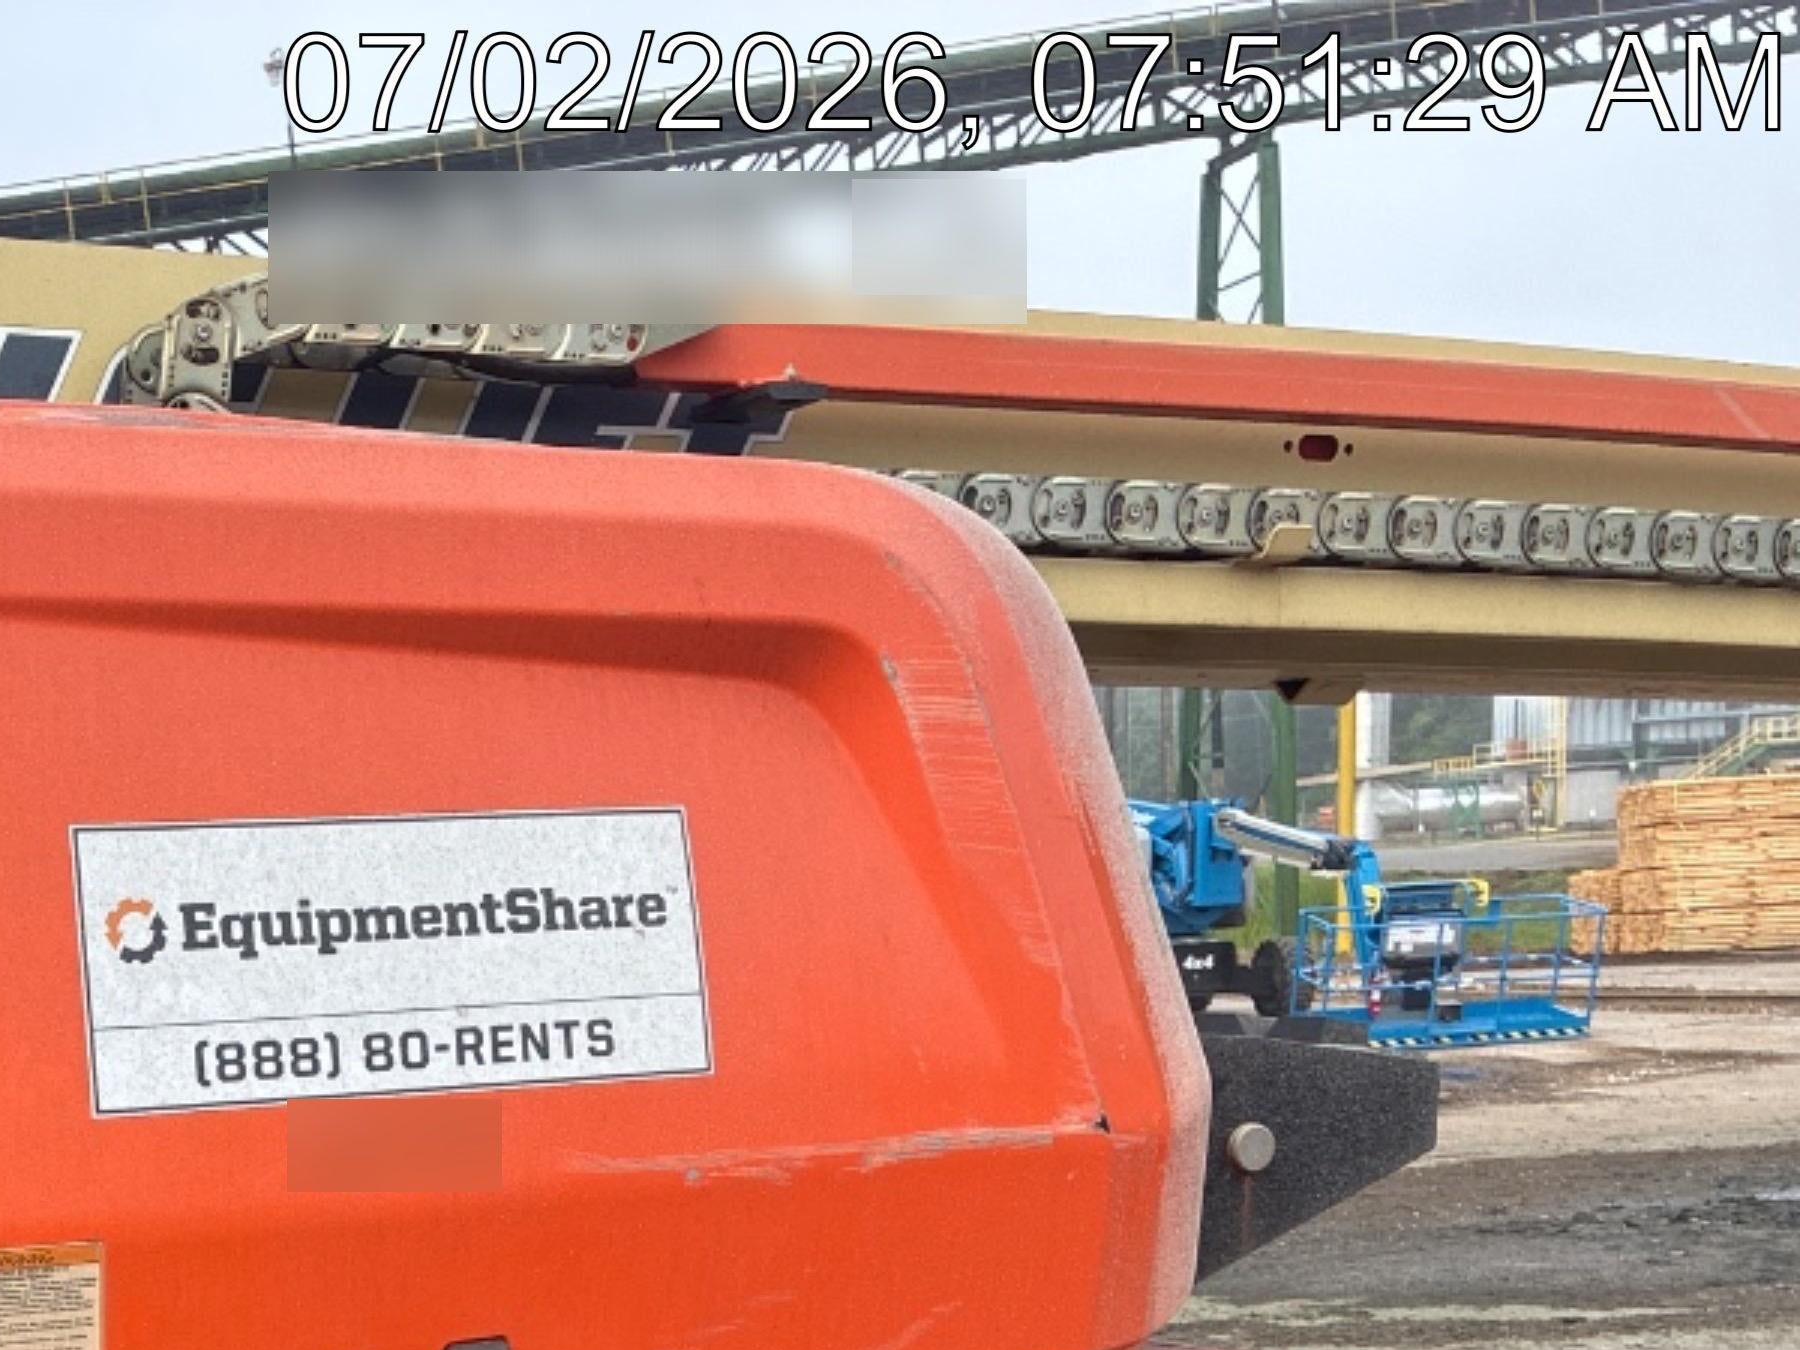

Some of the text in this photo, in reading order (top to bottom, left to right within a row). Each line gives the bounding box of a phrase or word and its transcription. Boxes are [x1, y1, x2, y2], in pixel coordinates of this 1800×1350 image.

[179, 887, 668, 959] EquipmentShare
[195, 1018, 615, 1087] (888) 80-RENTS
